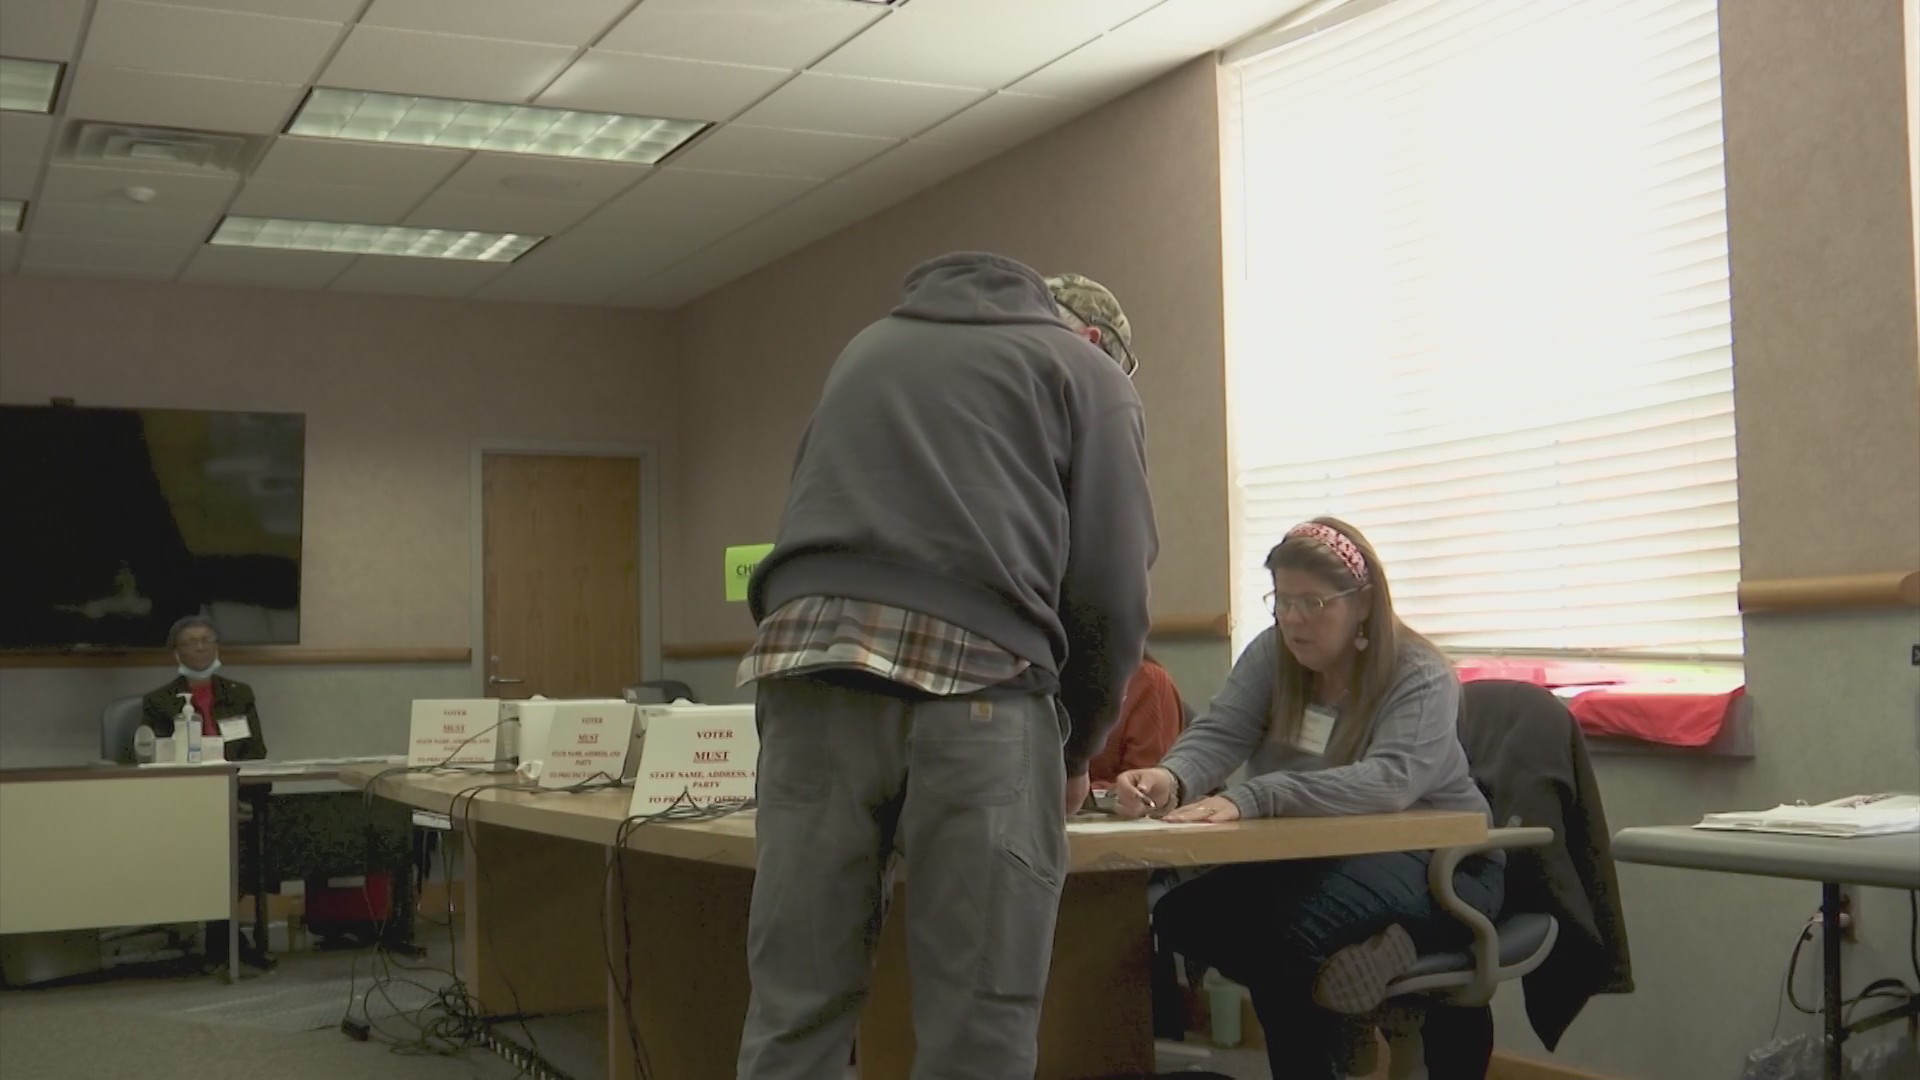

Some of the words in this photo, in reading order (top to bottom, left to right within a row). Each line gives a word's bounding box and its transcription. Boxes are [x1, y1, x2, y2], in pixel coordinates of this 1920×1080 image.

[577, 734, 599, 743] MUST
[697, 729, 733, 739] VOTER
[694, 751, 729, 762] MUST
[649, 771, 675, 779] STATE
[678, 771, 704, 779] NAME,
[662, 796, 711, 804] PRCNCT
